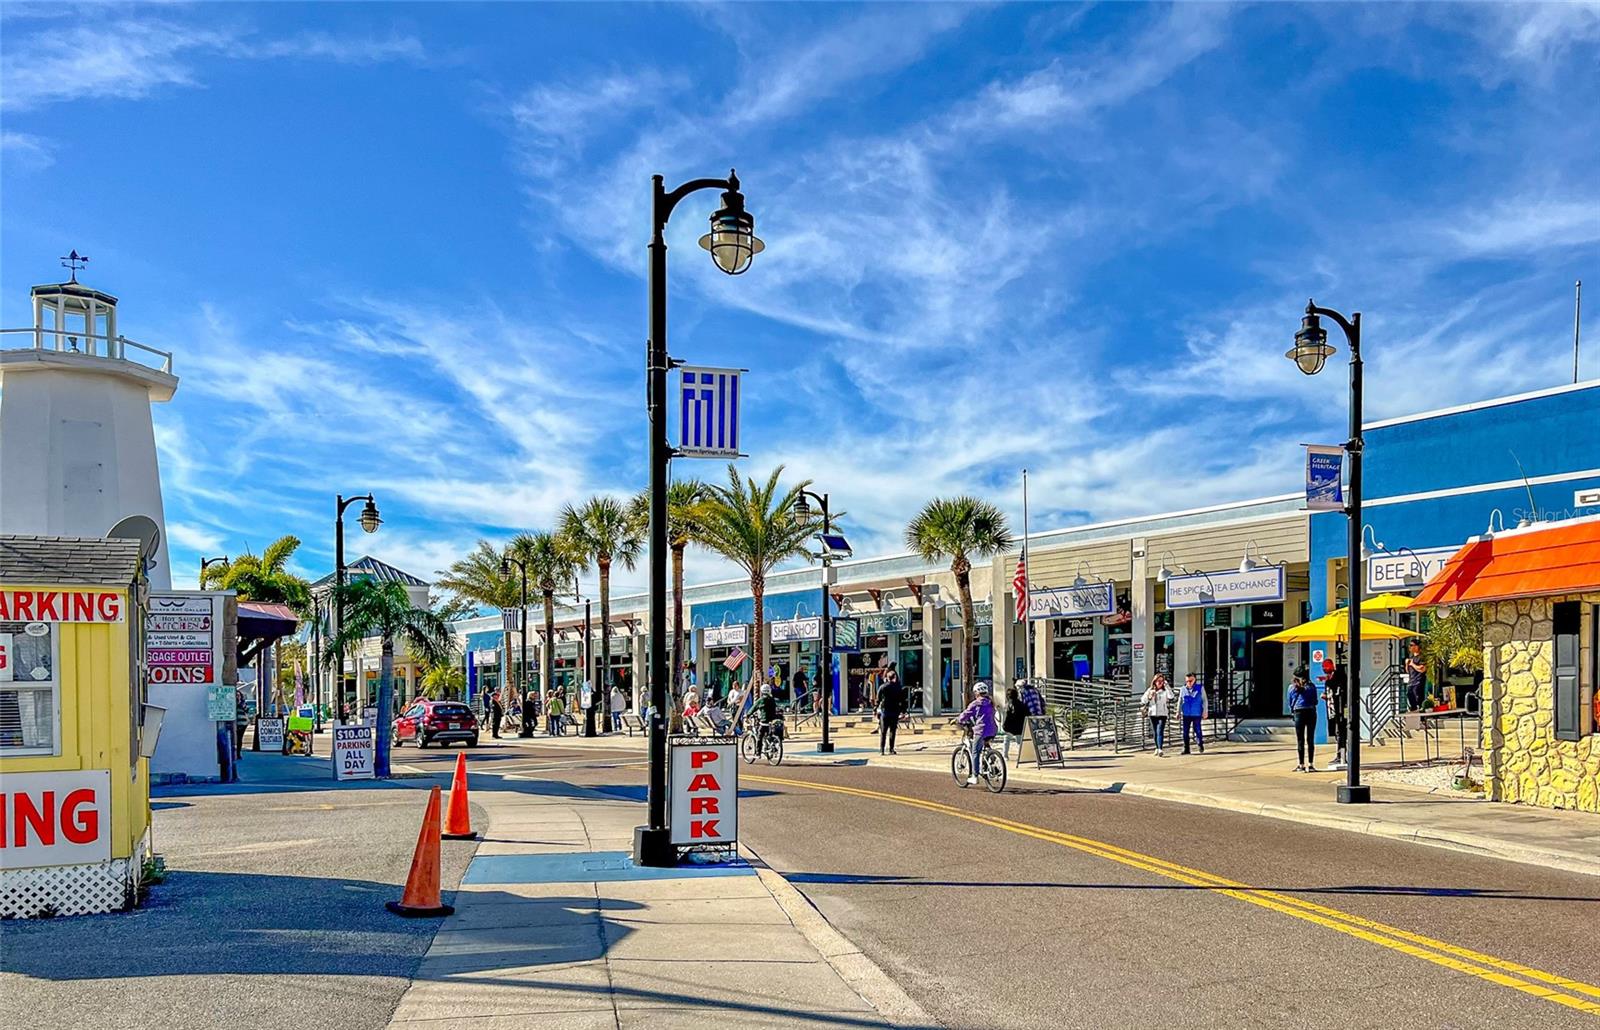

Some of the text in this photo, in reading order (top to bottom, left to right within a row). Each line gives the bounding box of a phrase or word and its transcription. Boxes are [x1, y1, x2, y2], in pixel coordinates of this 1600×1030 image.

[1375, 559, 1449, 581] BEE BY T
[1170, 578, 1277, 596] THE SPICE & TEA EXCHANGE
[1072, 592, 1109, 608] FLAGS
[155, 622, 199, 630] KITCHEN
[795, 622, 817, 637] SHOP
[177, 652, 210, 662] OUTLET
[148, 667, 205, 683] OINS
[262, 719, 279, 727] COINS
[260, 727, 282, 735] COMICS
[337, 729, 370, 740] $10.00
[337, 741, 371, 750] PARKING
[345, 750, 364, 760] ALL
[344, 760, 366, 769] DAY
[687, 751, 721, 838] PARK
